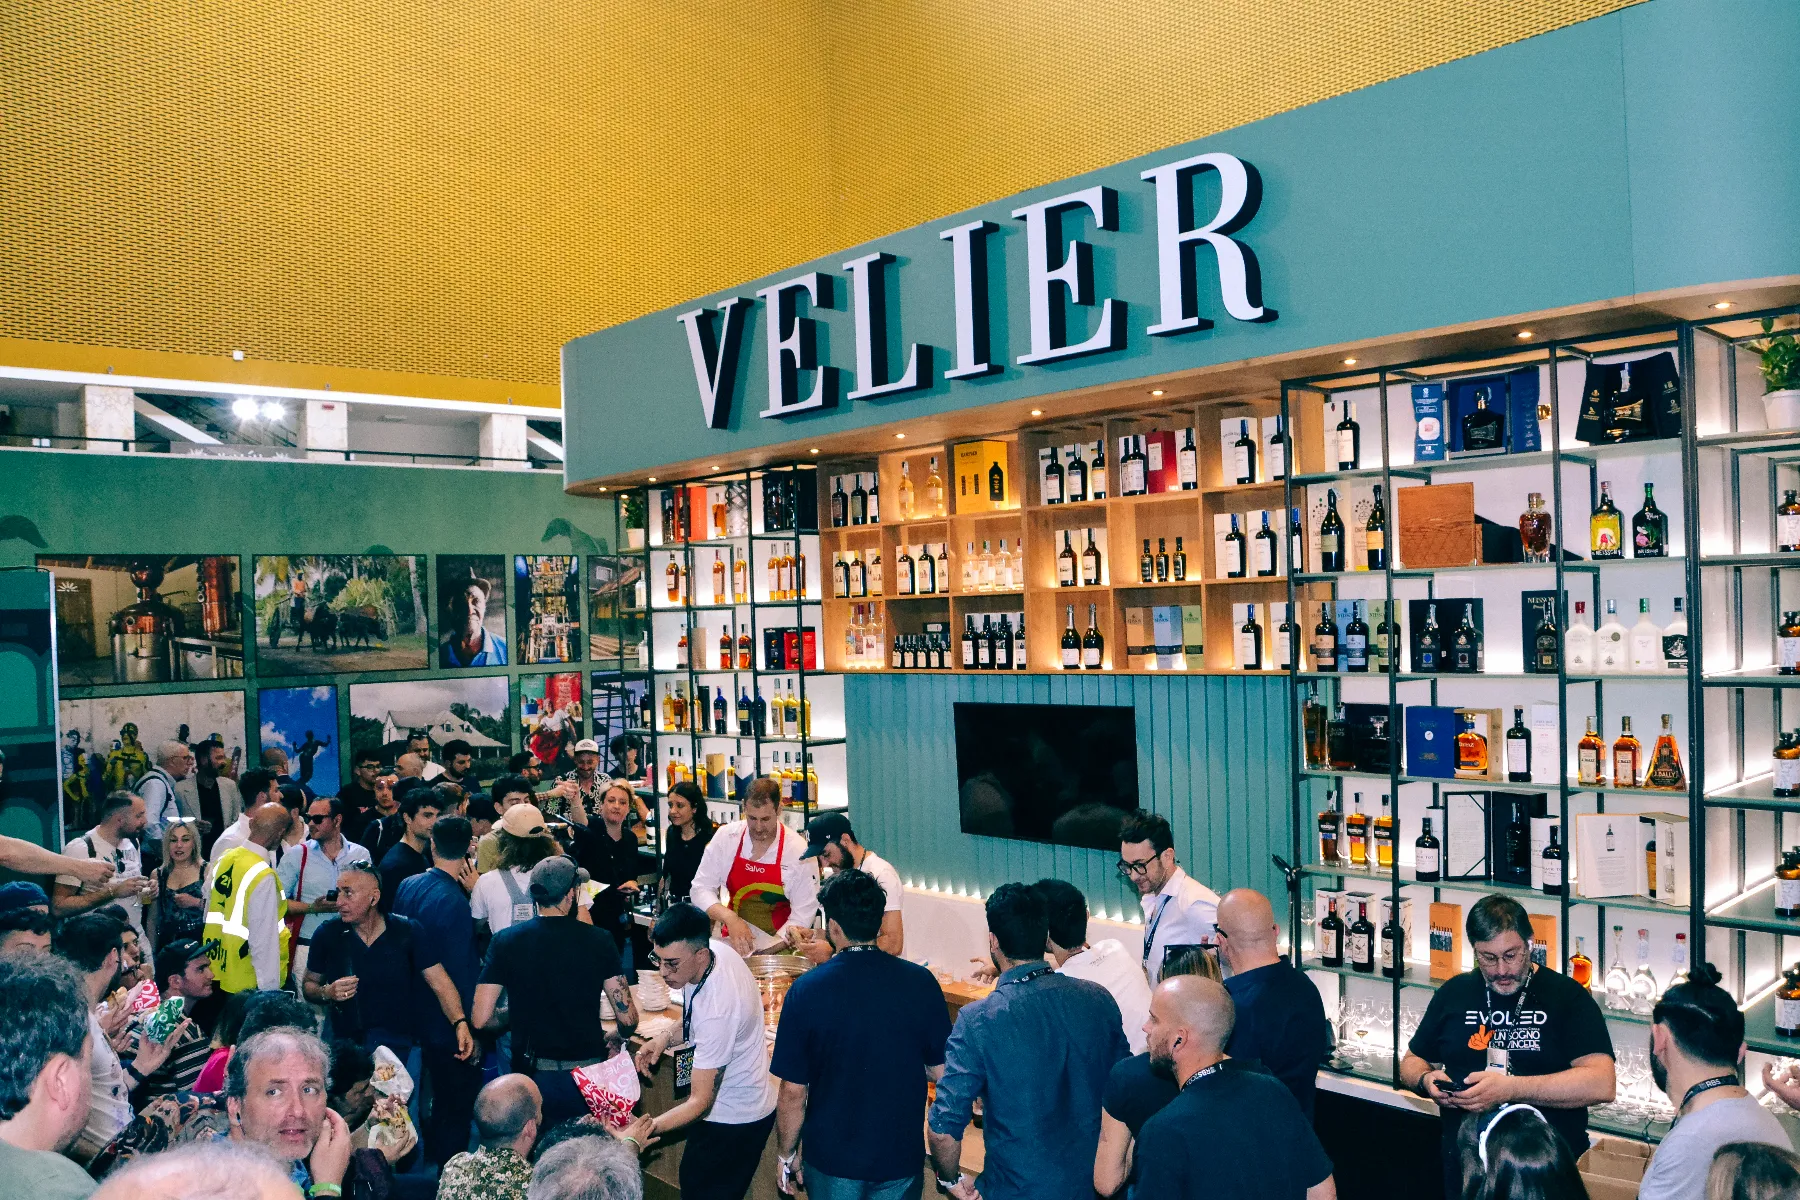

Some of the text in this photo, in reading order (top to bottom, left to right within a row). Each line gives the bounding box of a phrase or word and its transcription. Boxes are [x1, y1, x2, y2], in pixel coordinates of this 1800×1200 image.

[677, 152, 1278, 430] VELIER
[745, 863, 766, 874] Salvo
[1705, 1079, 1721, 1088] RBS
